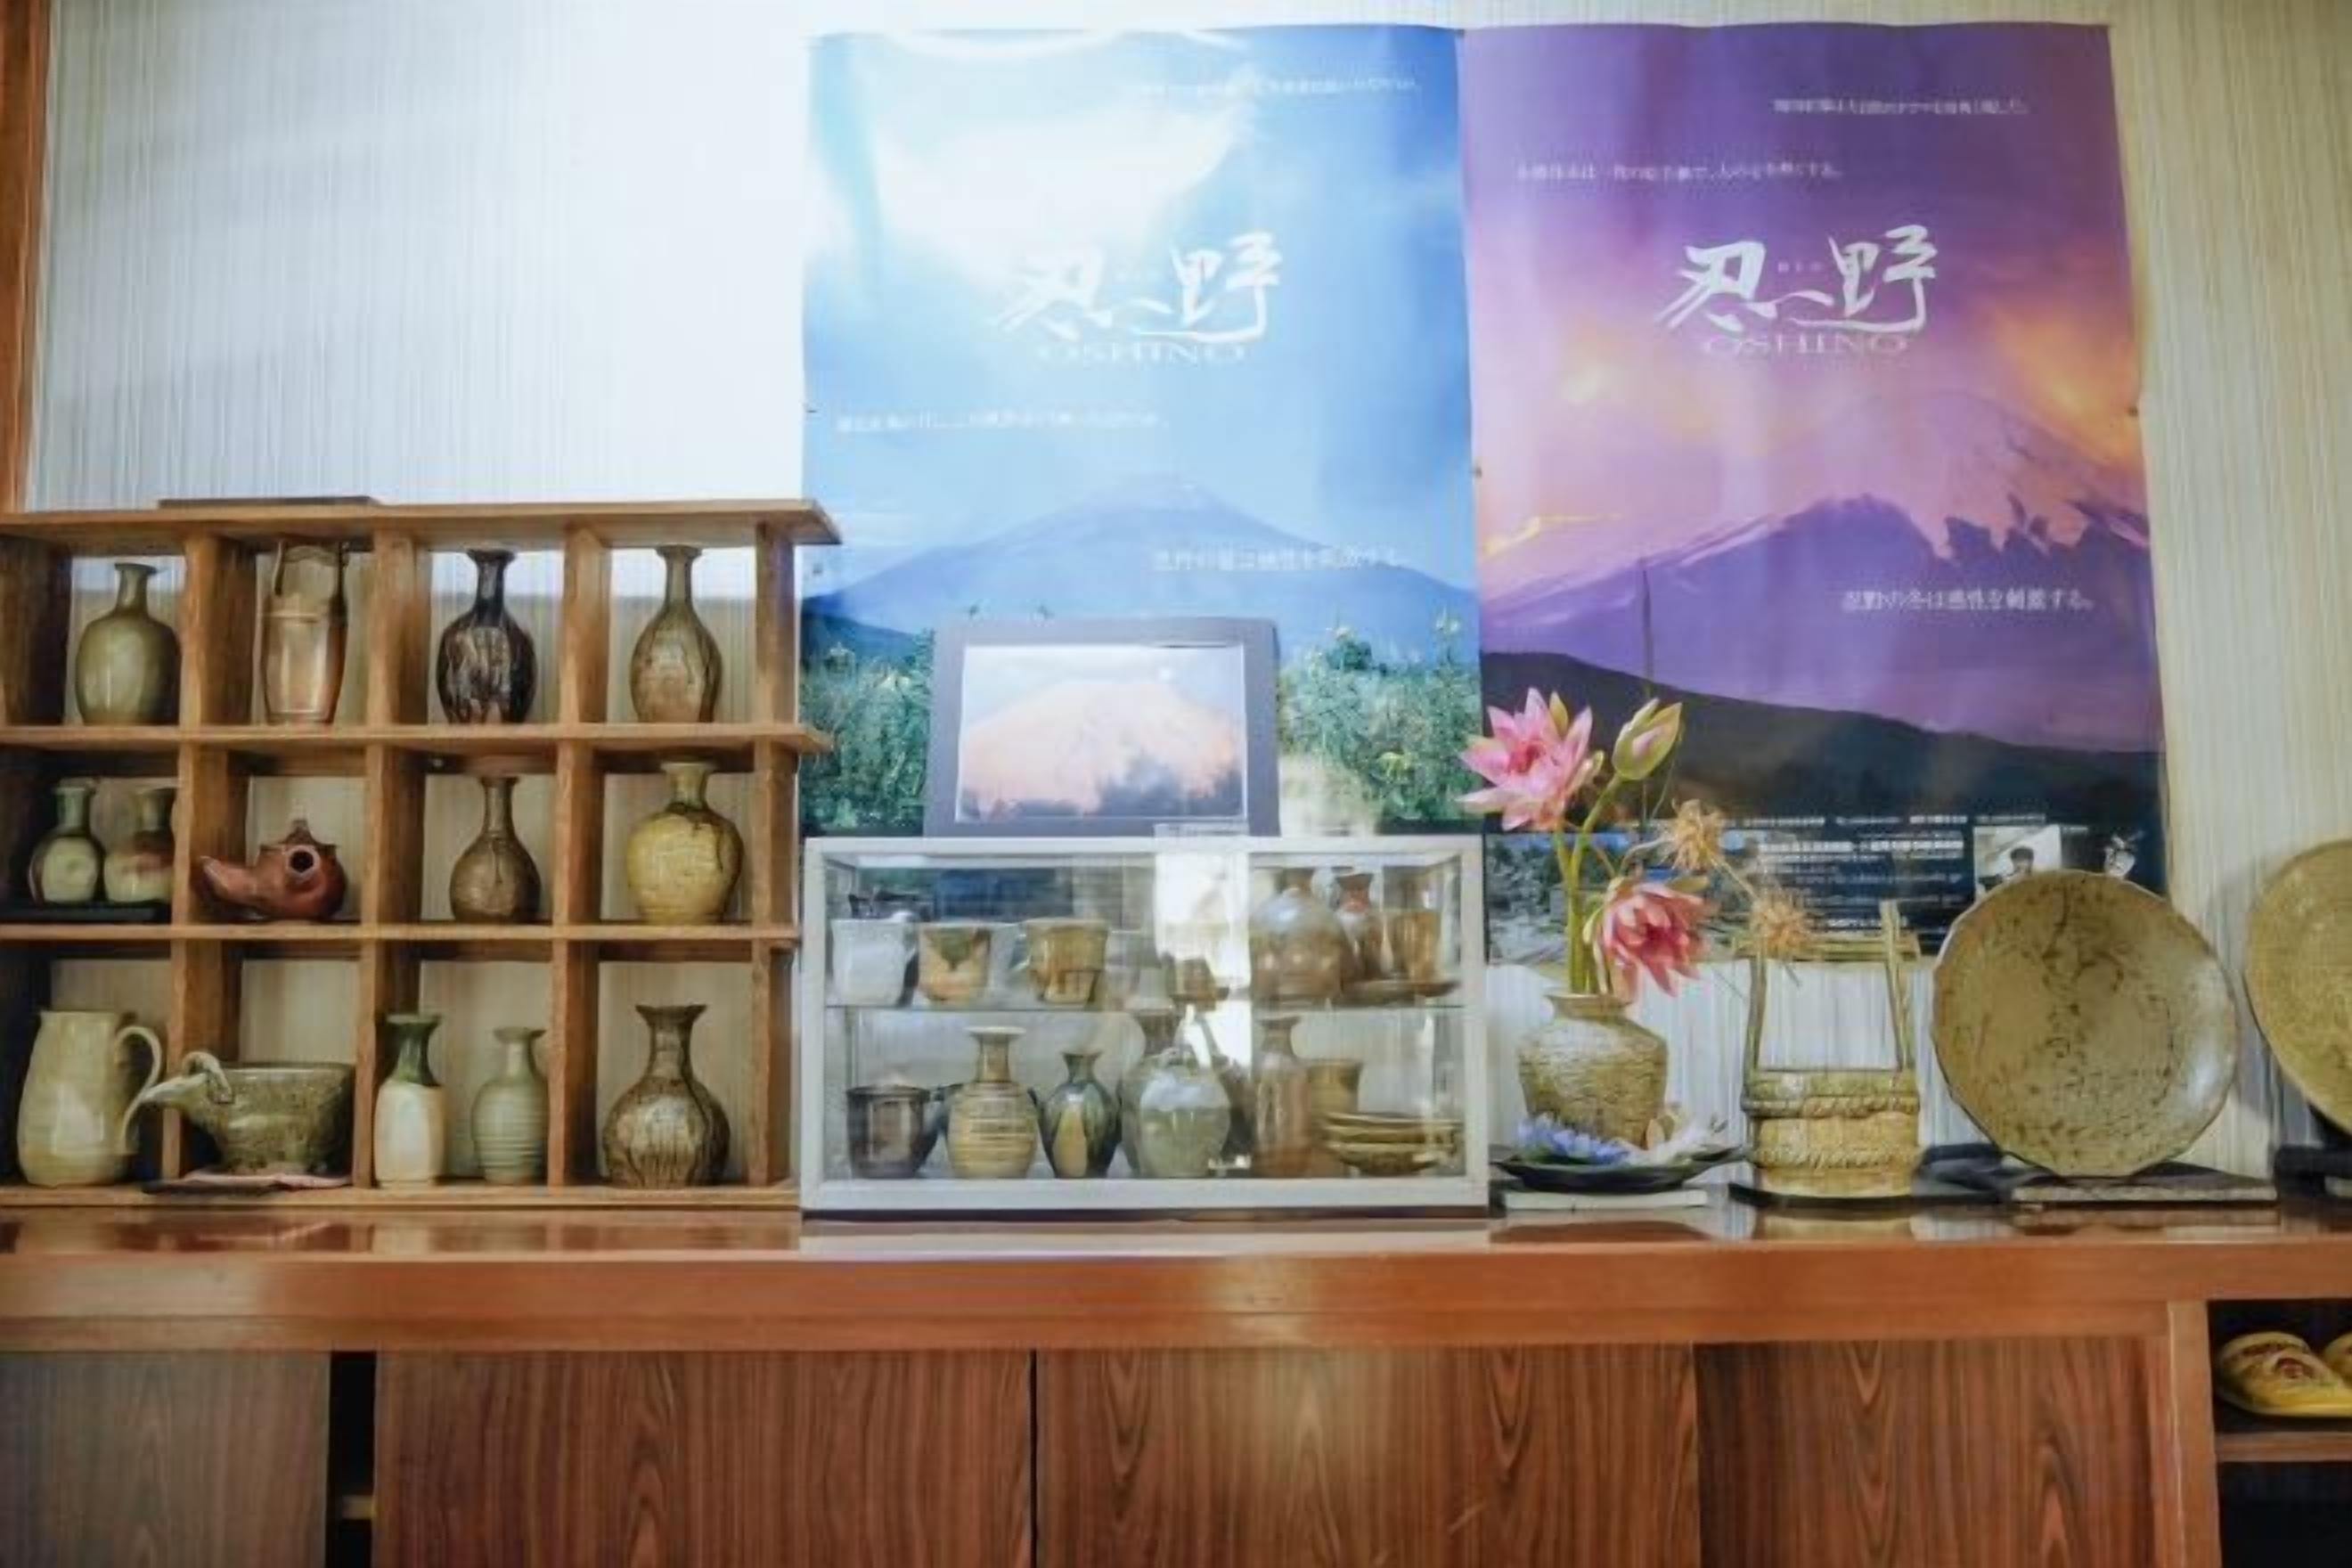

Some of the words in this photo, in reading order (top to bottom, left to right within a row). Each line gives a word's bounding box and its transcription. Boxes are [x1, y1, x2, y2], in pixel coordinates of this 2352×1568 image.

[991, 231, 1284, 342] 忍野
[1655, 224, 1939, 333] 忍野
[1701, 333, 1908, 355] OSHINO
